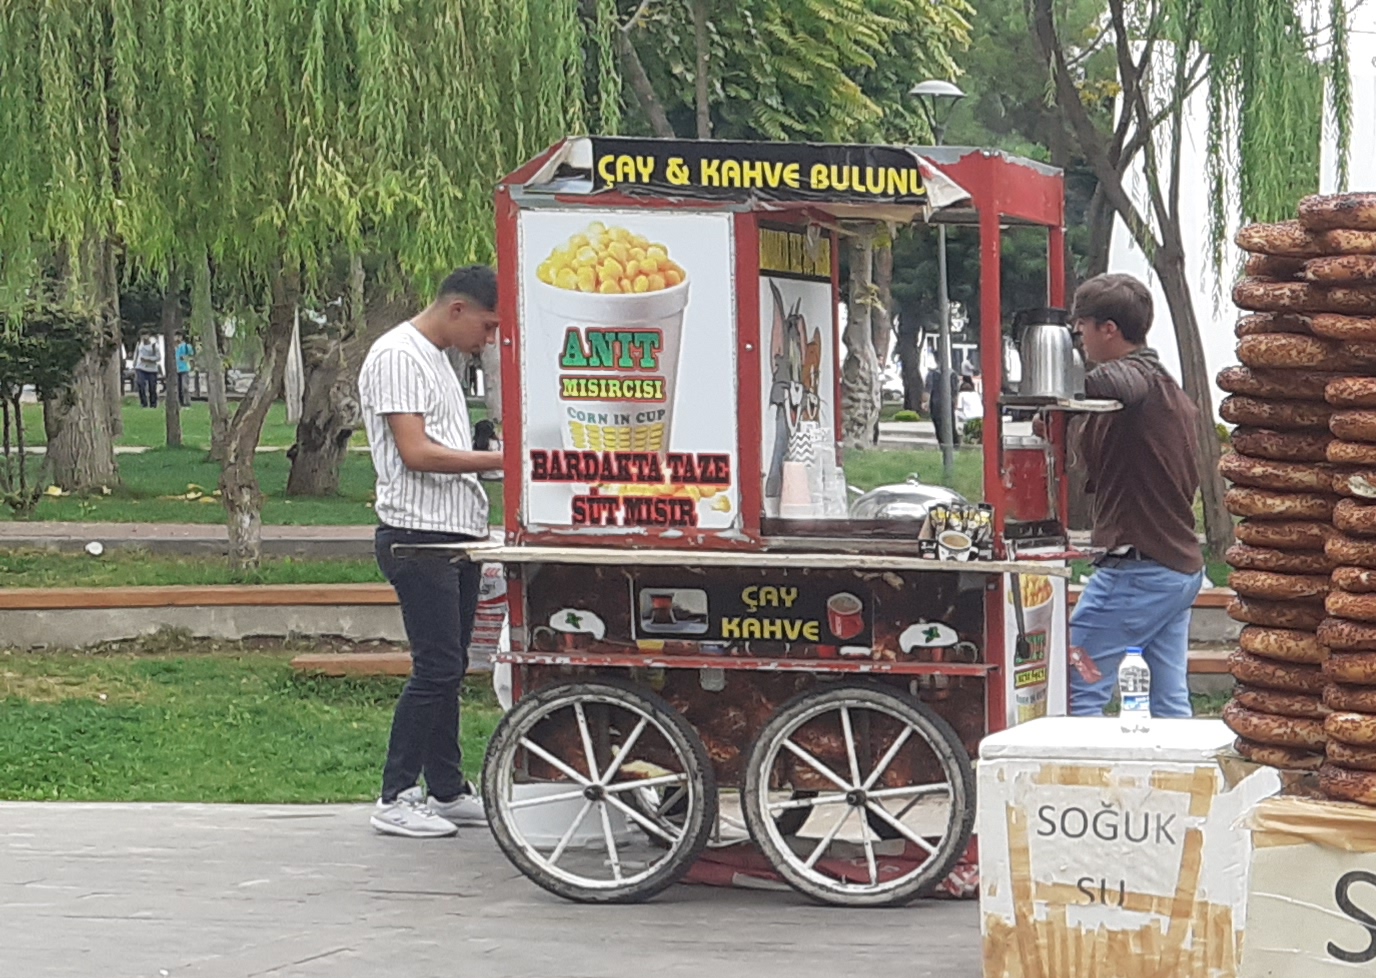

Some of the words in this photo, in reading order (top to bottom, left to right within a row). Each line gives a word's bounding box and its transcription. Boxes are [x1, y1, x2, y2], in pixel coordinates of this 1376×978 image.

[598, 154, 653, 190] ÇAY
[666, 158, 691, 186] &
[701, 159, 799, 188] KAHVE
[560, 329, 662, 369] ANIT
[562, 377, 664, 400] MISIRCISI
[567, 407, 609, 425] CORN
[613, 413, 631, 425] IN
[635, 408, 666, 422] CUP
[530, 450, 664, 483] BARDAKTA
[666, 453, 730, 485] TAZE
[572, 487, 620, 526] SÜT
[623, 496, 698, 528] MISIR
[741, 586, 798, 613] ÇAY
[722, 616, 820, 642] KAHVE
[1037, 800, 1176, 845] SOĞUK
[1077, 877, 1126, 906] SU
